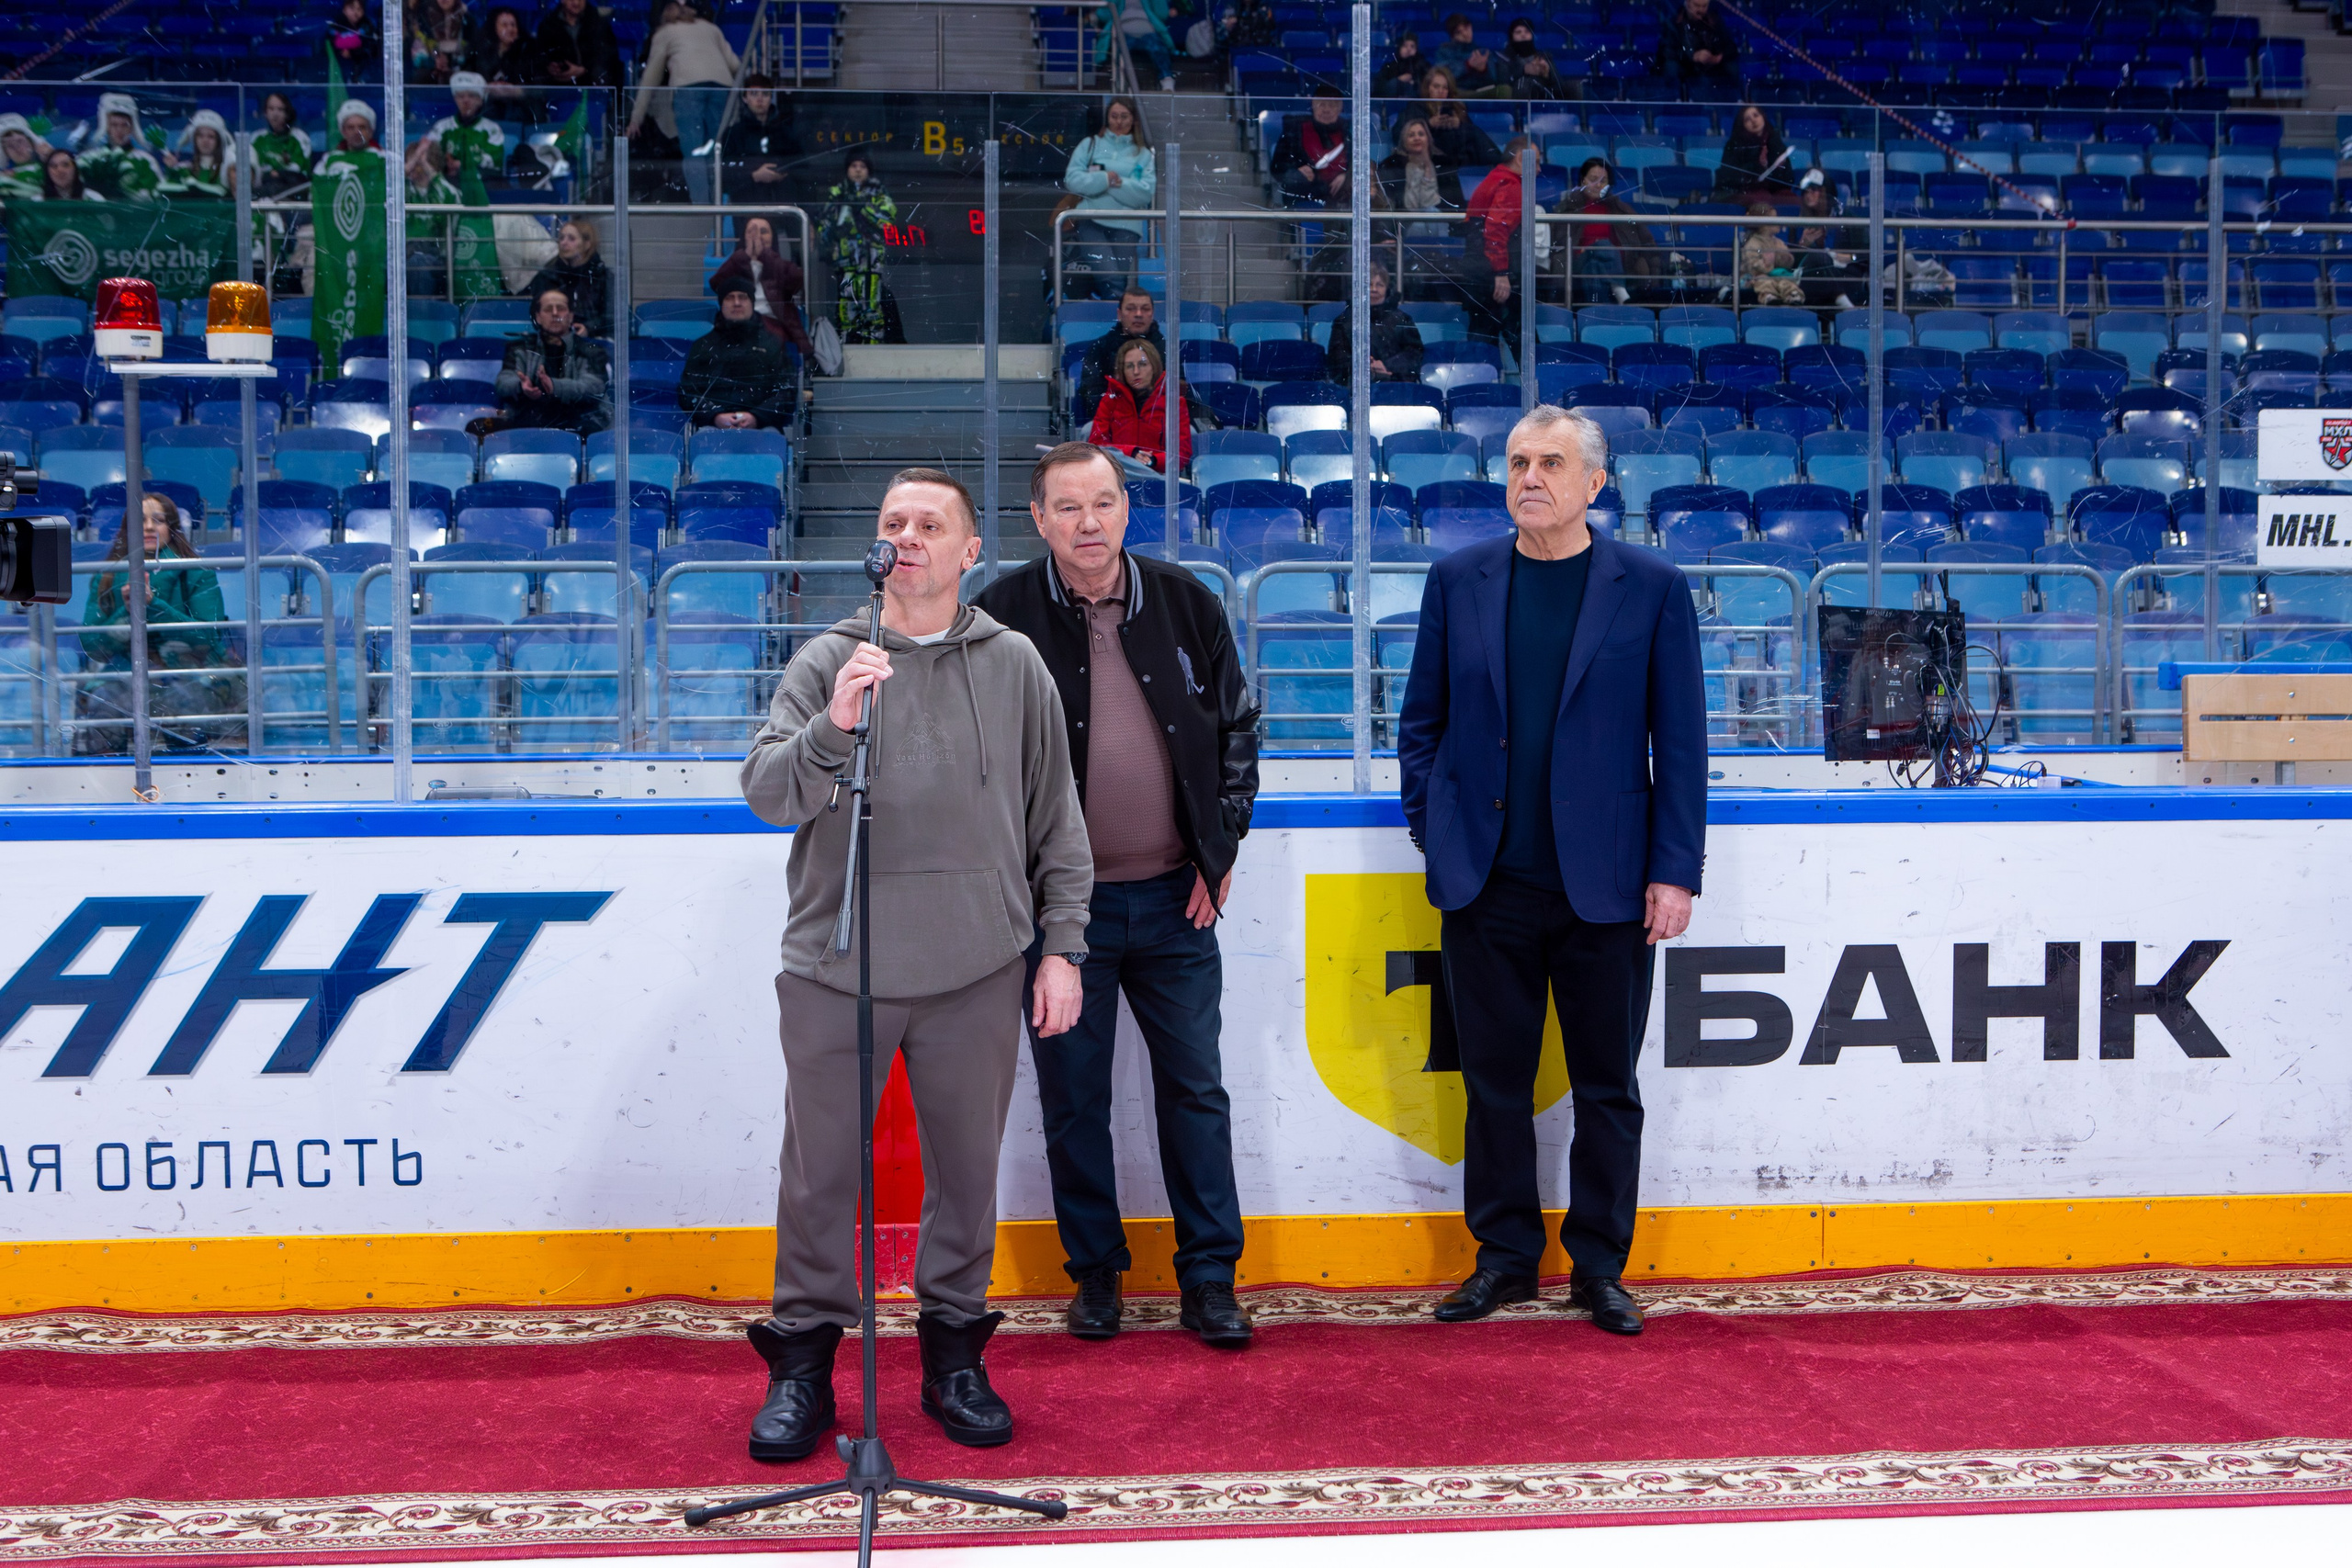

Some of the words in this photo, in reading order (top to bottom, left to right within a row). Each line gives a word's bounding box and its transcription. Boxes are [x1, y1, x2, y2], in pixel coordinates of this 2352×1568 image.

[816, 130, 894, 143] СЕКТОР
[1001, 133, 1064, 145] ECTOR
[104, 243, 209, 272] segezha
[153, 268, 209, 288] group
[342, 248, 358, 344] segez
[1664, 940, 2231, 1068] БАНК
[96, 1137, 423, 1192] ОБЛАСТЬ
